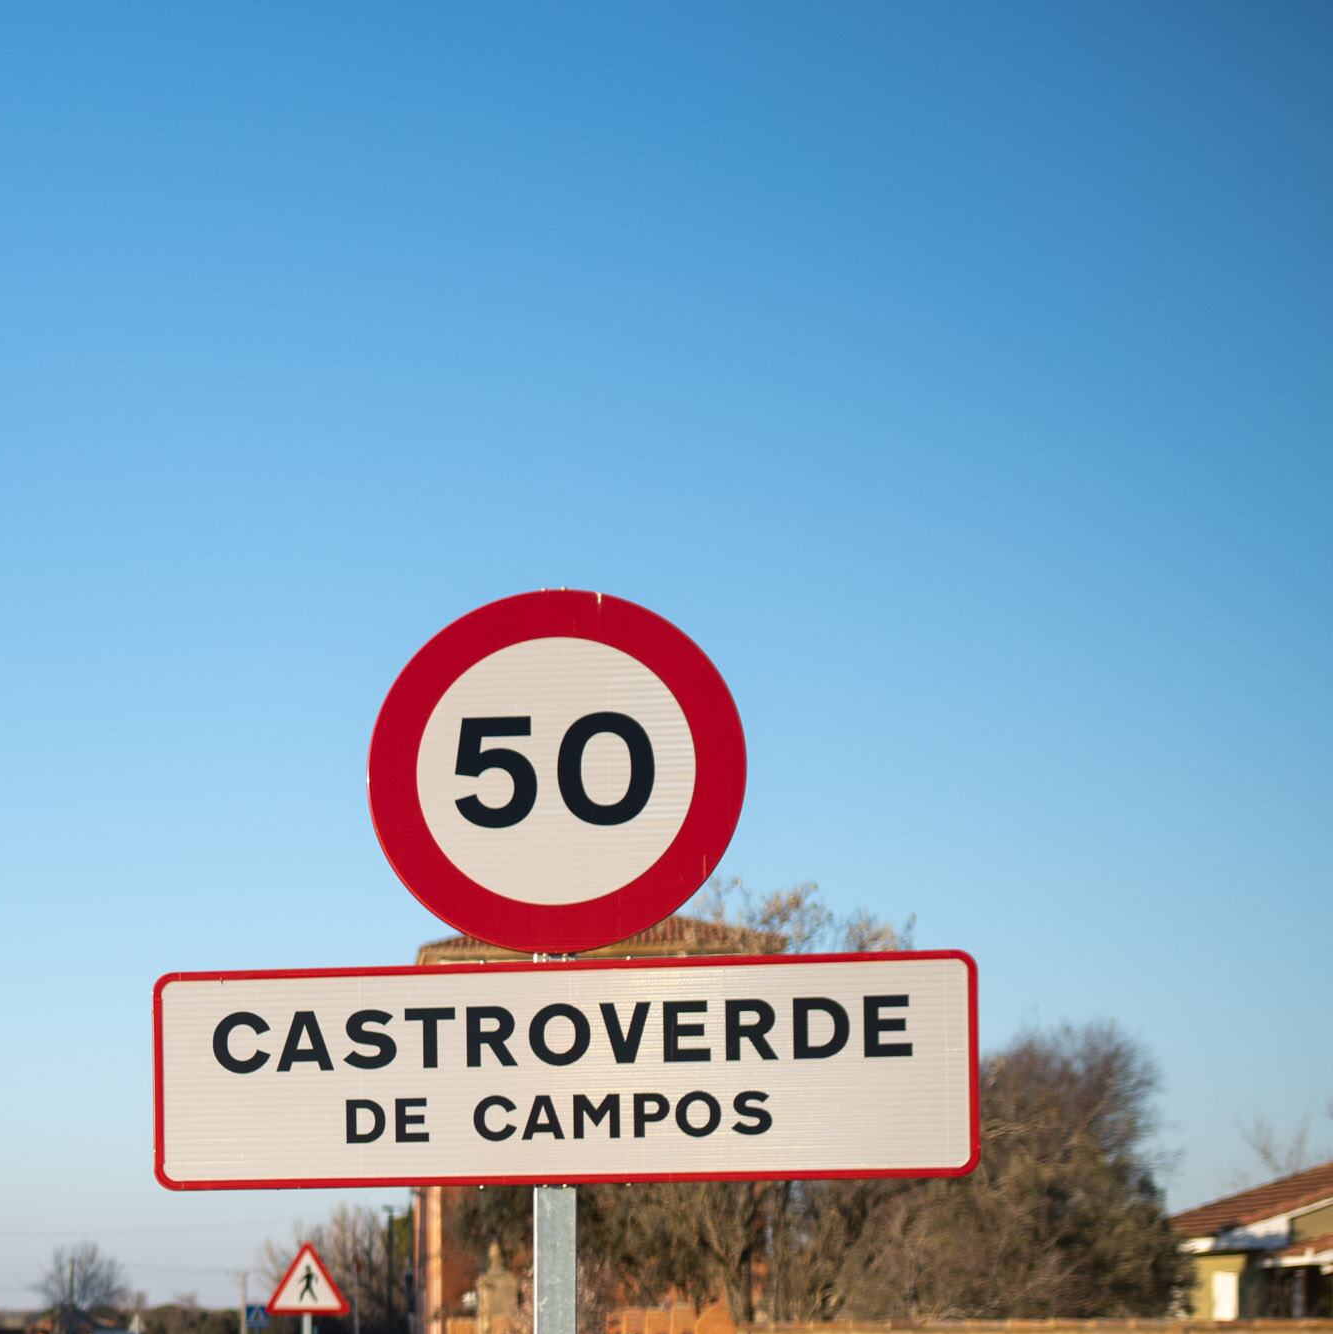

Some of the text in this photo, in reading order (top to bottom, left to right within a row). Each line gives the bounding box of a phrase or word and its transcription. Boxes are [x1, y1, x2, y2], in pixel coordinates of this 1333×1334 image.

[454, 711, 655, 829] 50
[212, 994, 913, 1074] CASTROVERDE
[345, 1090, 773, 1144] DE CAMPOS
